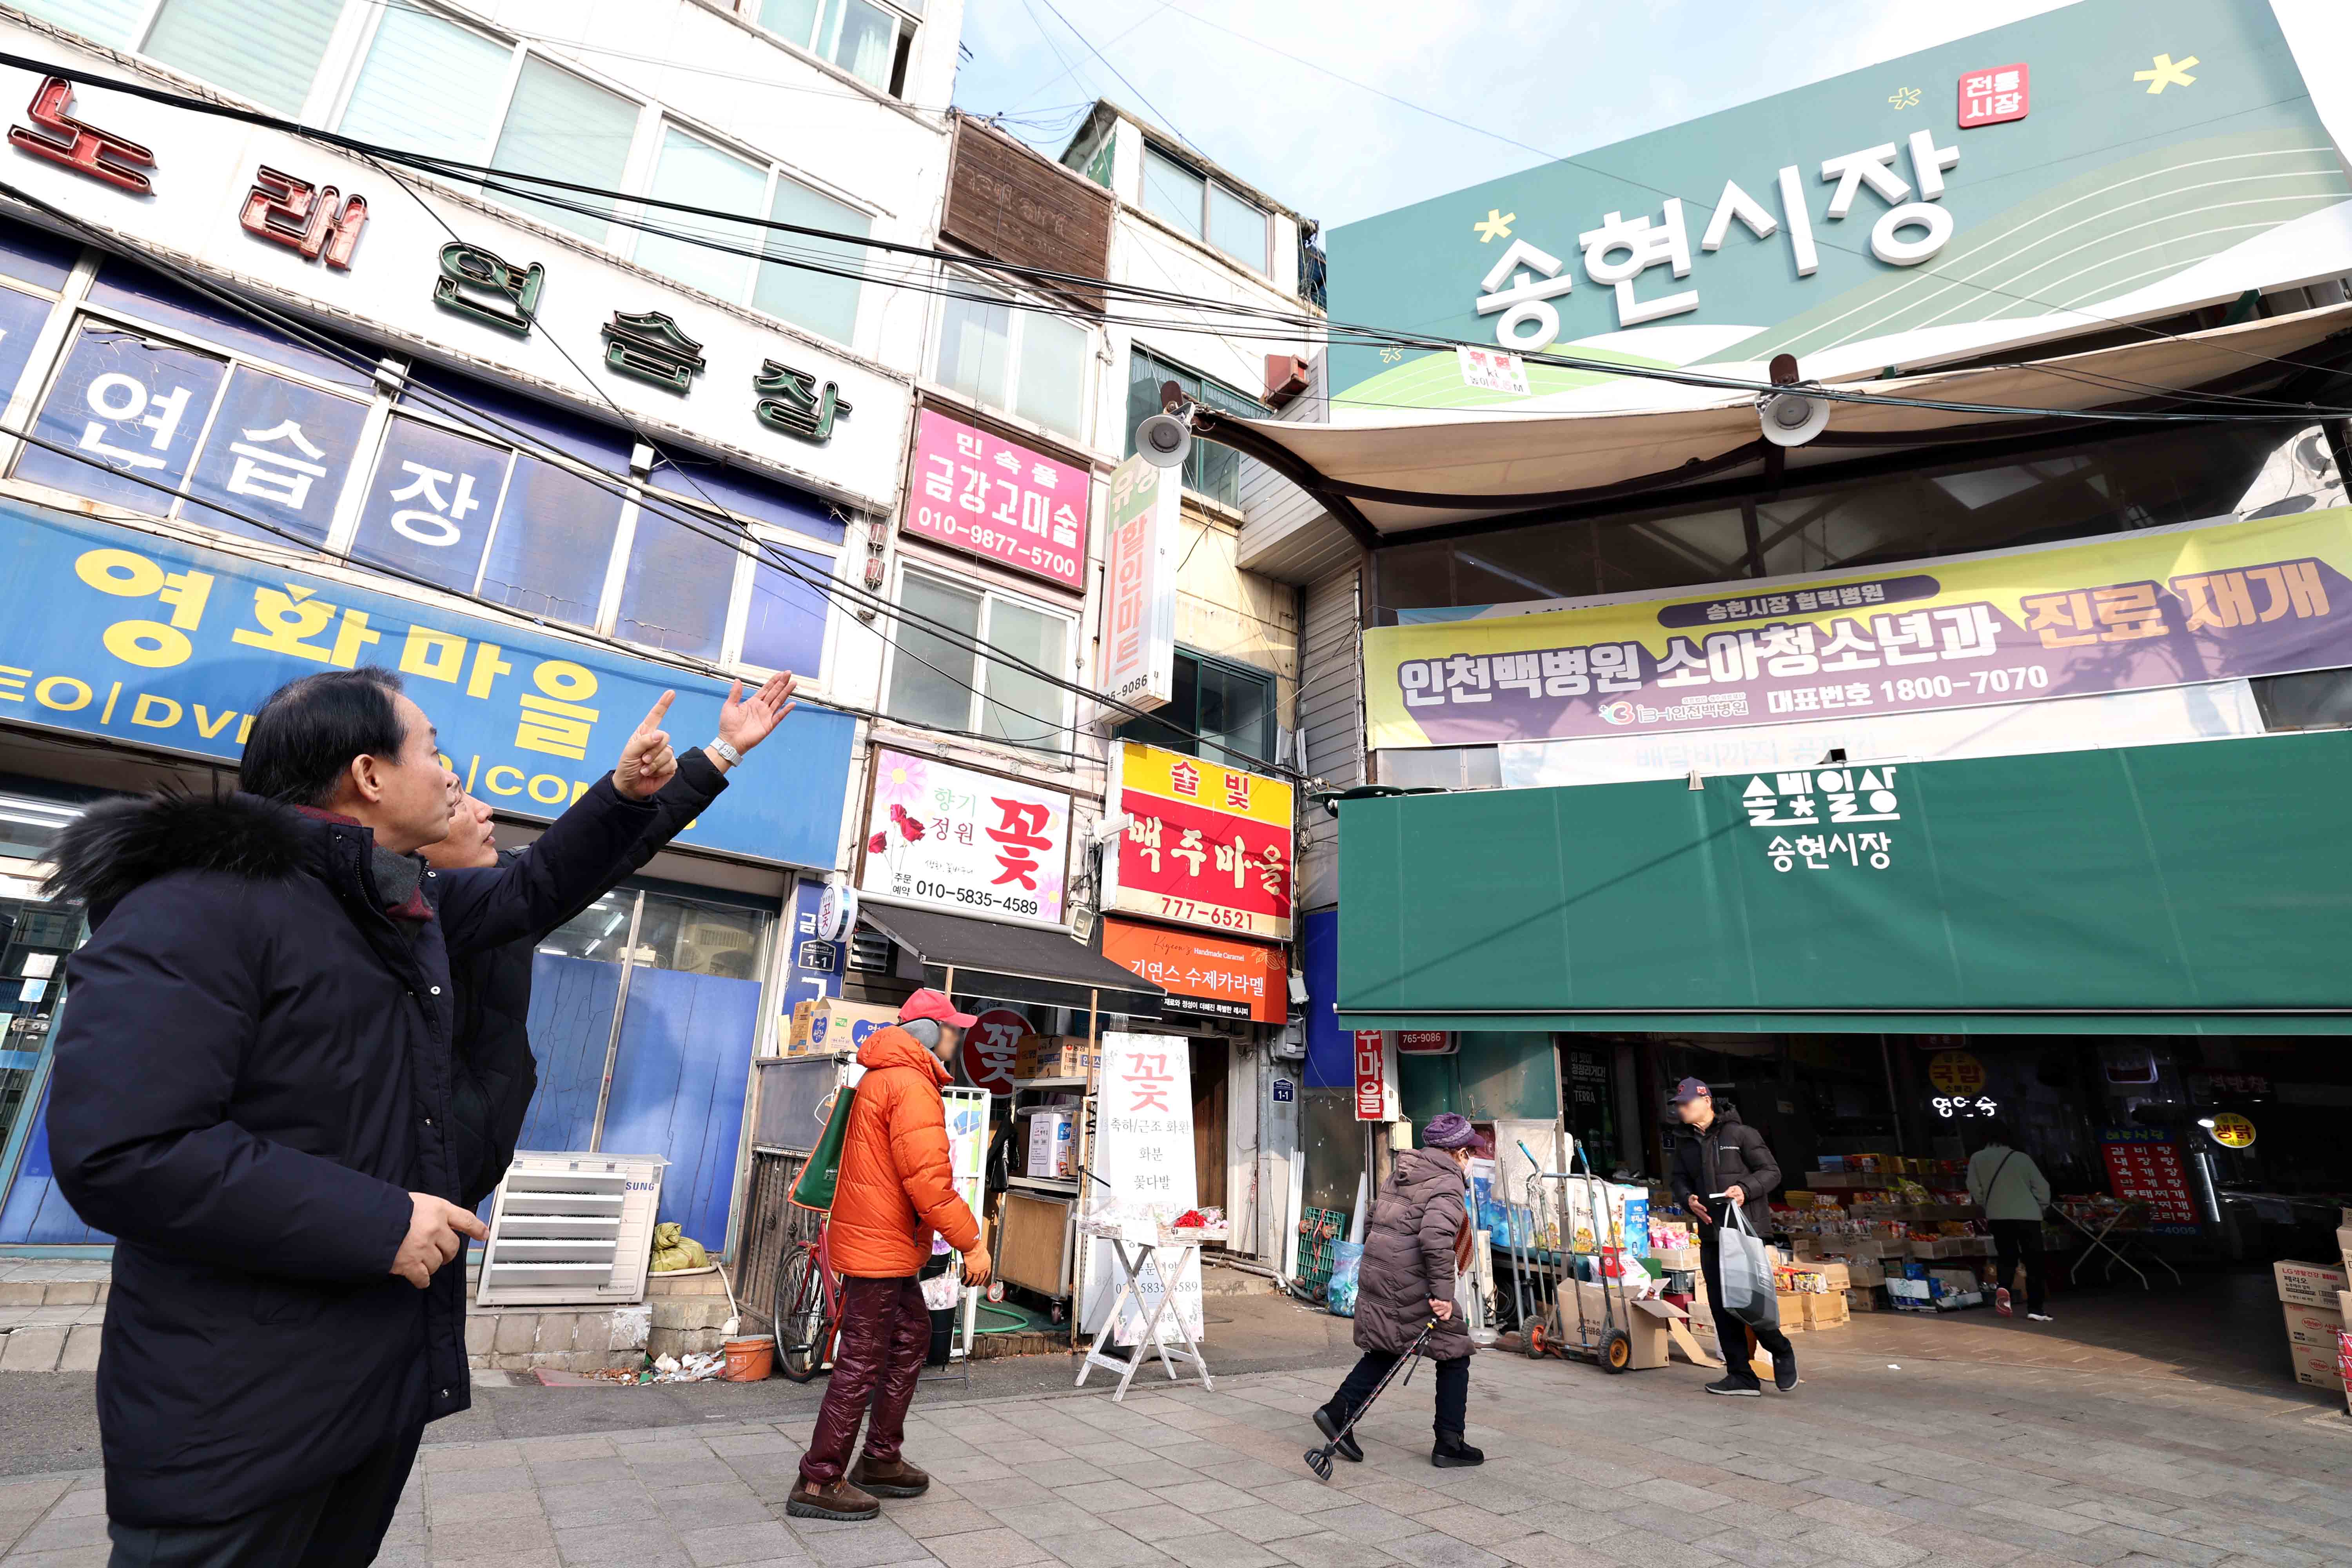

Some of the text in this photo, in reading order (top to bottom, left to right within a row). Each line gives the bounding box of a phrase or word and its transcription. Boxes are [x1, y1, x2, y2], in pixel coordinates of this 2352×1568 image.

[1966, 70, 2020, 98] 전통
[1966, 92, 2022, 120] 시장
[1476, 129, 1960, 353] 송현시장
[432, 240, 853, 442] 연습장
[78, 372, 479, 547] 연습장
[925, 453, 1078, 549] 금강고미술
[918, 506, 1075, 577] 010-9877-5700
[1114, 514, 1148, 677] 할인마트
[1706, 583, 1885, 622] 송현시장 협력병원
[1401, 561, 2330, 707] 인천백병원 소아청소년과 진료 재개
[74, 548, 600, 760] 영화마을
[1767, 665, 2049, 713] 대표번호 1800-7070
[1671, 700, 1749, 721] 인천백병원
[1170, 760, 1251, 811] 솔빛
[934, 787, 977, 817] 향기
[930, 817, 974, 846] 정원
[985, 796, 1053, 891] 꽃
[1128, 816, 1284, 896] 맥주마을
[1767, 832, 1891, 873] 송현시장
[893, 884, 911, 897] 예약
[894, 872, 911, 884] 주문
[916, 880, 1038, 915] 010-5835-4589
[822, 902, 831, 929] 꽃
[1161, 897, 1253, 930] 777-6521
[808, 955, 827, 968] 1-1
[1194, 948, 1223, 959] Handmade
[1223, 952, 1245, 962] Caramel
[1131, 959, 1264, 997] 기연스 수제카라멜
[1164, 998, 1181, 1007] 재료와
[1181, 1000, 1198, 1010] 정성이
[1199, 1002, 1215, 1012] 더해진
[1233, 1007, 1249, 1016] 레시피
[975, 1022, 1024, 1085] 꽃
[1403, 1033, 1441, 1043] 765-9086
[1121, 1053, 1174, 1112] 꽃
[1931, 1065, 1981, 1083] 국밥
[1278, 1090, 1289, 1100] 1-1
[1573, 1090, 1596, 1103] TERRA
[1110, 1118, 1162, 1133] 축하/근조
[1166, 1120, 1191, 1134] 화환
[2215, 1124, 2252, 1139] 생닭
[1139, 1147, 1163, 1161] 화분
[1134, 1174, 1171, 1190] 꽃다발
